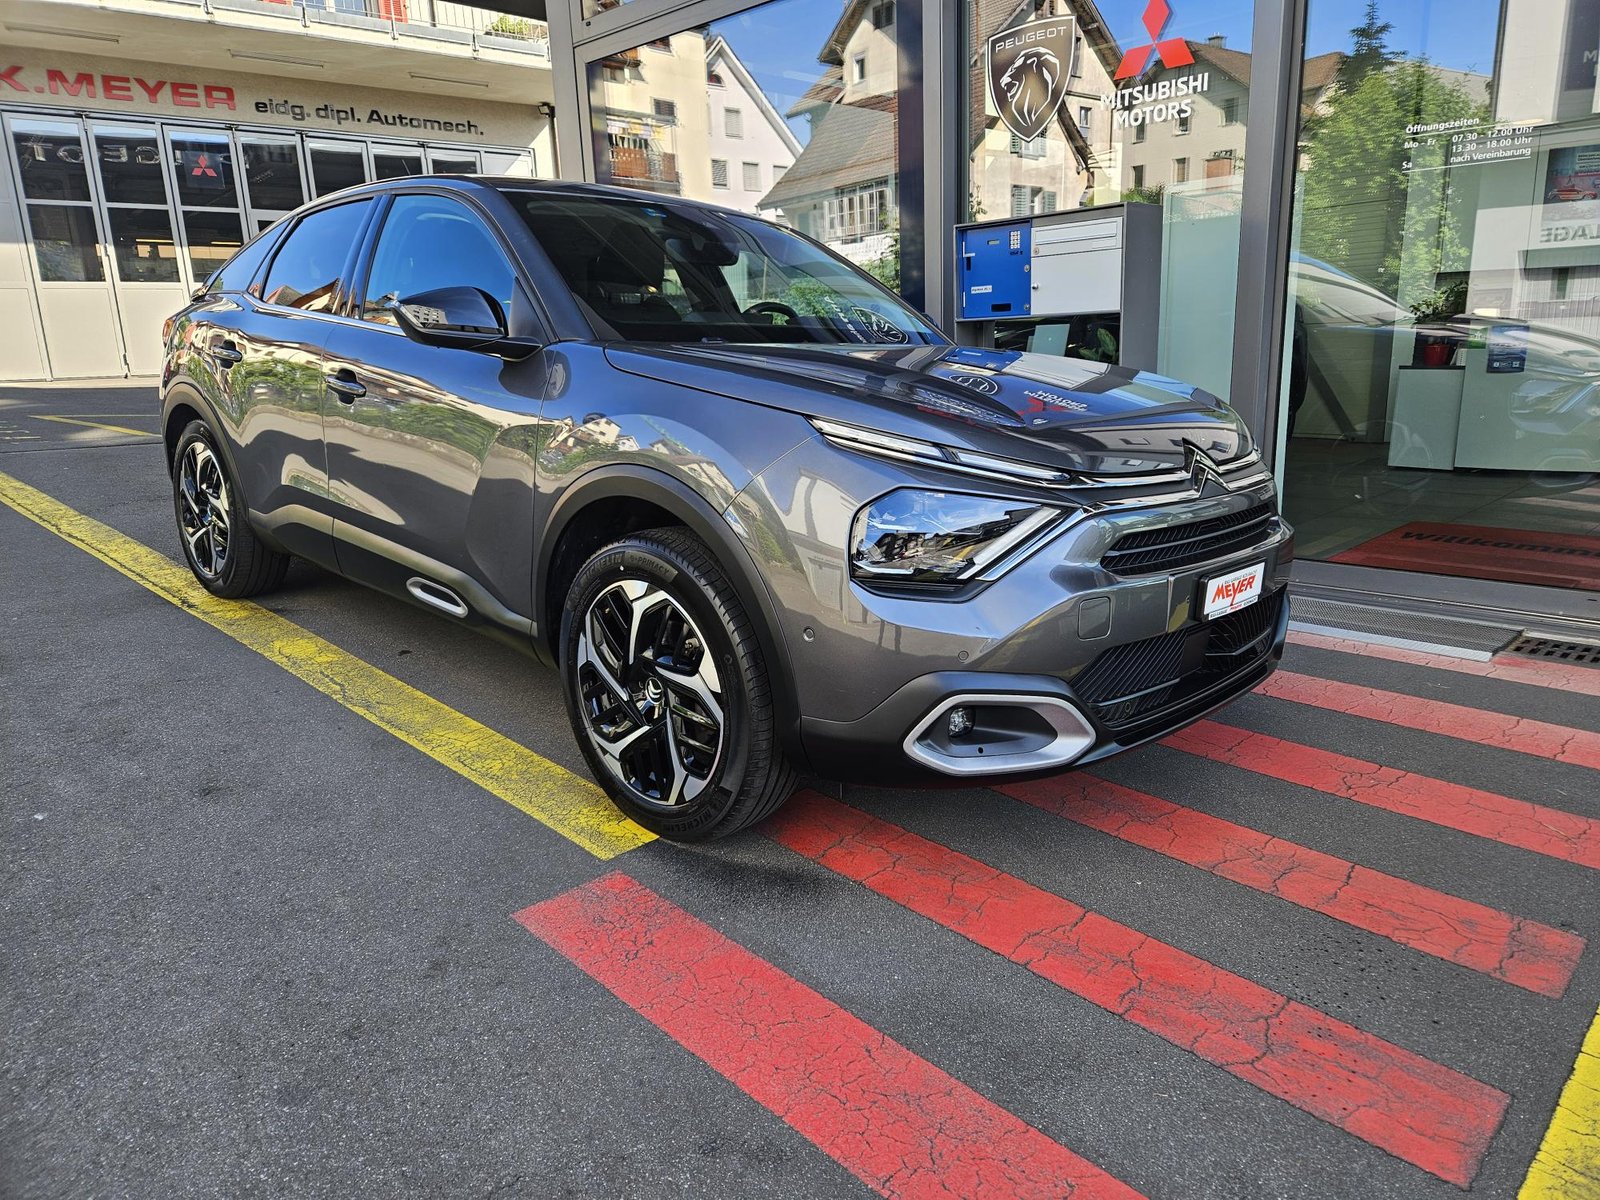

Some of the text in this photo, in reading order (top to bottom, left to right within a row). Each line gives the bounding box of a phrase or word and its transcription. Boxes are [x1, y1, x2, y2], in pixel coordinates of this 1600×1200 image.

[994, 25, 1067, 53] PEUGEOT
[0, 65, 237, 111] K.MEYER
[1100, 72, 1209, 111] MITSUBISHI
[254, 98, 484, 136] eidg. dipl. Automech.
[1113, 98, 1192, 129] MOTORS
[1405, 117, 1480, 134] Öffnungszeiten
[1404, 140, 1419, 149] Mo
[1427, 138, 1437, 146] Fr
[1452, 132, 1478, 143] 07.30
[1488, 128, 1513, 137] 12.00
[1515, 125, 1534, 134] Uhr
[1452, 142, 1477, 153] 13.30
[1487, 138, 1512, 148] 18.00
[1515, 136, 1533, 145] Uhr
[1402, 161, 1413, 169] Sa
[1450, 147, 1531, 163] nach Vereinbarung
[1400, 531, 1600, 557] Willkomm
[1211, 575, 1256, 606] MEYER
